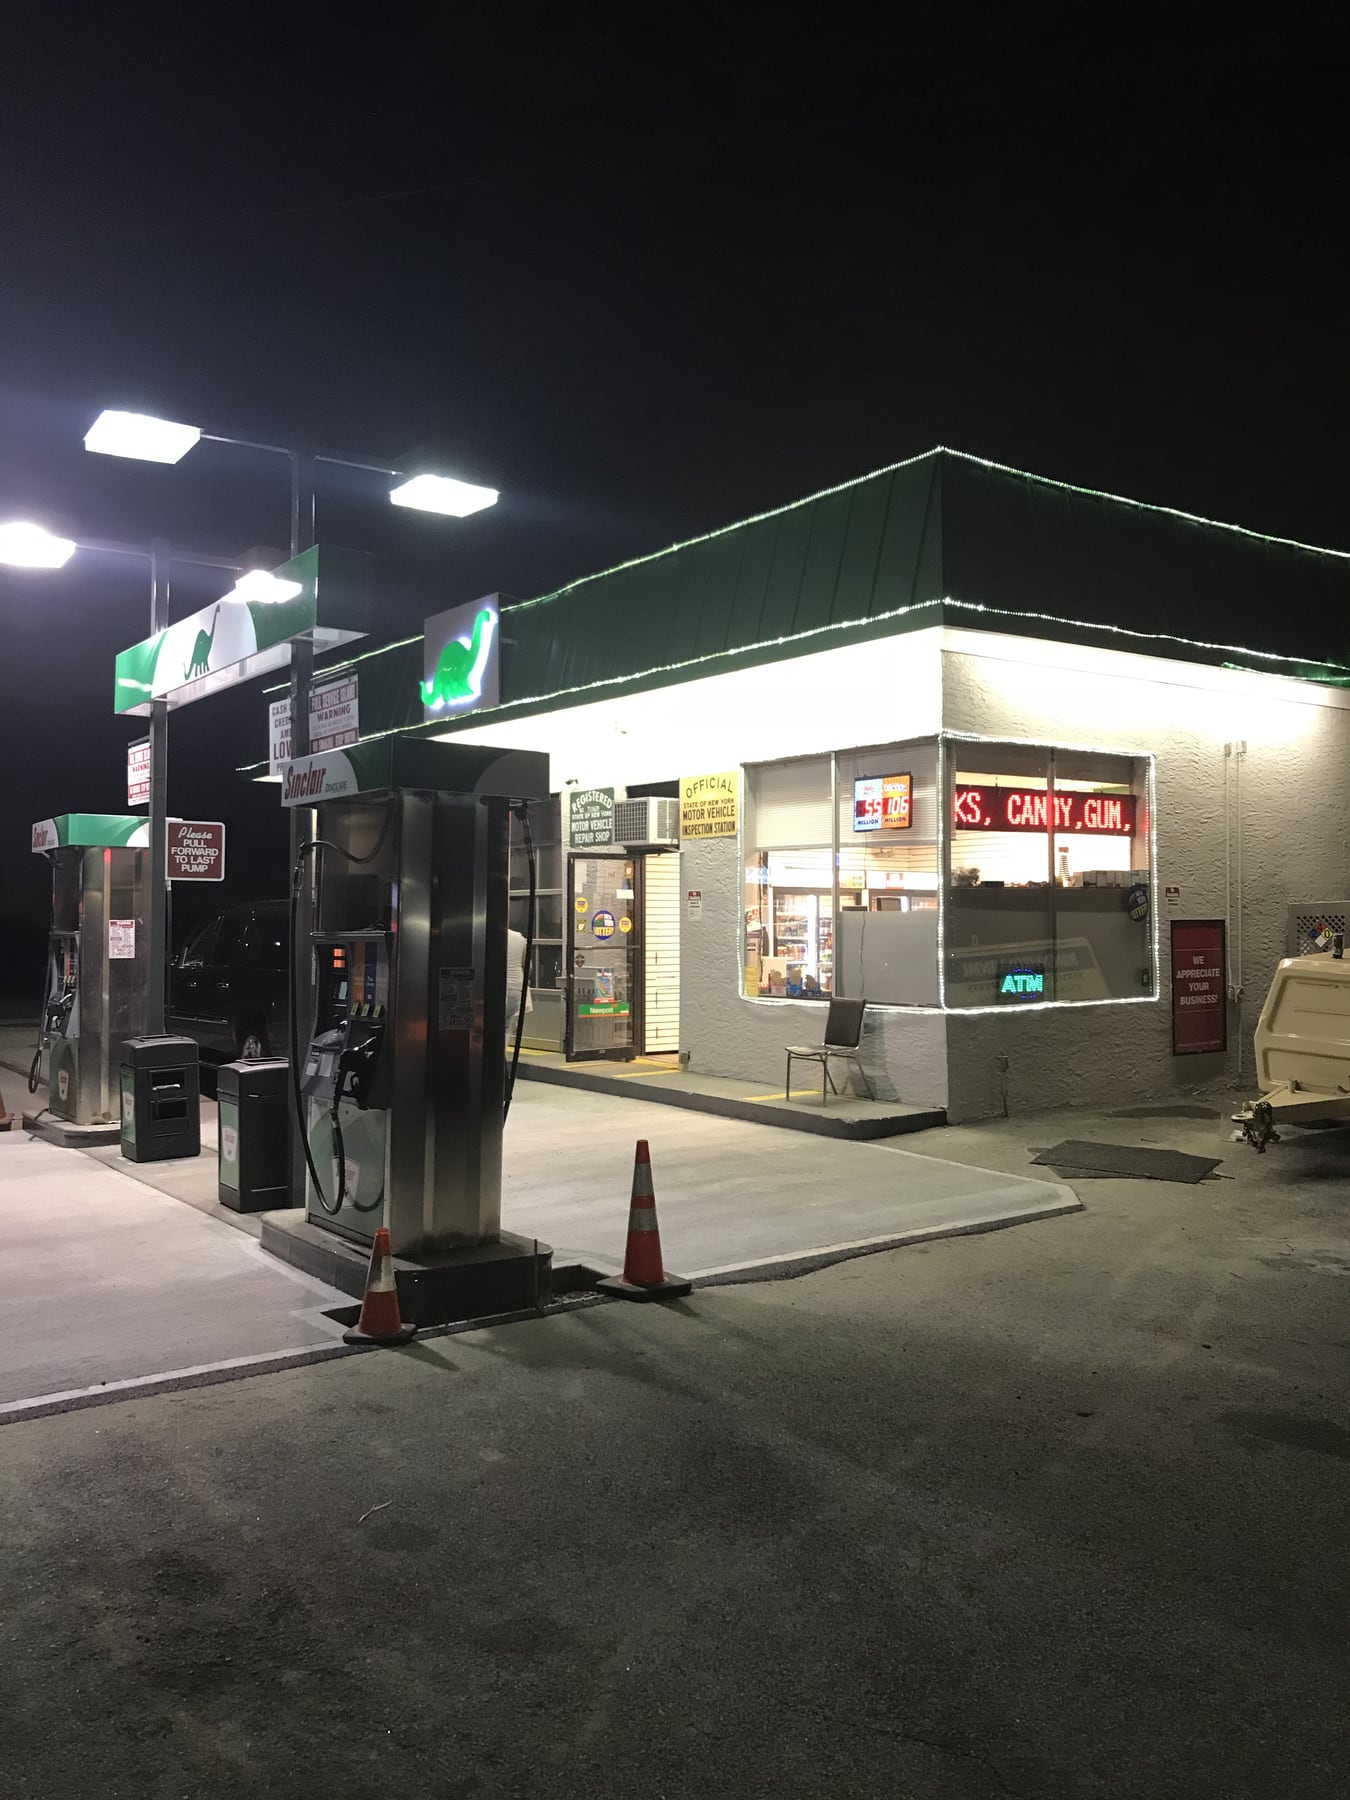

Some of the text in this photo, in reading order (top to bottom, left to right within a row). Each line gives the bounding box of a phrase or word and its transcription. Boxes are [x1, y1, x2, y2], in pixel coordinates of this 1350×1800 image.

[272, 704, 288, 717] CASH
[317, 704, 351, 722] WARNING
[275, 716, 291, 728] CRED
[285, 761, 326, 800] Sinclair
[686, 777, 733, 798] OFFICIAL
[572, 790, 612, 813] REGISTERED
[683, 801, 698, 809] STATE
[721, 797, 734, 805] YORK
[865, 798, 881, 817] 55
[888, 796, 909, 815] 106
[683, 805, 735, 821] MOTOR VEHICLE
[571, 818, 612, 832] MOTOR VEHICLE
[682, 820, 736, 836] INSPECTION STATION
[178, 826, 213, 839] Please
[575, 831, 610, 844] REPAIR SHOP
[183, 839, 207, 848] PULL
[171, 847, 219, 856] FORWARD
[174, 855, 216, 864] TO LAST
[181, 864, 208, 872] PUMP
[1192, 955, 1205, 965] WE
[1176, 968, 1220, 979] APPRECIATE
[1001, 975, 1043, 993] ATM
[1188, 982, 1209, 991] YOUR
[1180, 995, 1218, 1006] BUSINESS!
[590, 1007, 614, 1015] Newport
